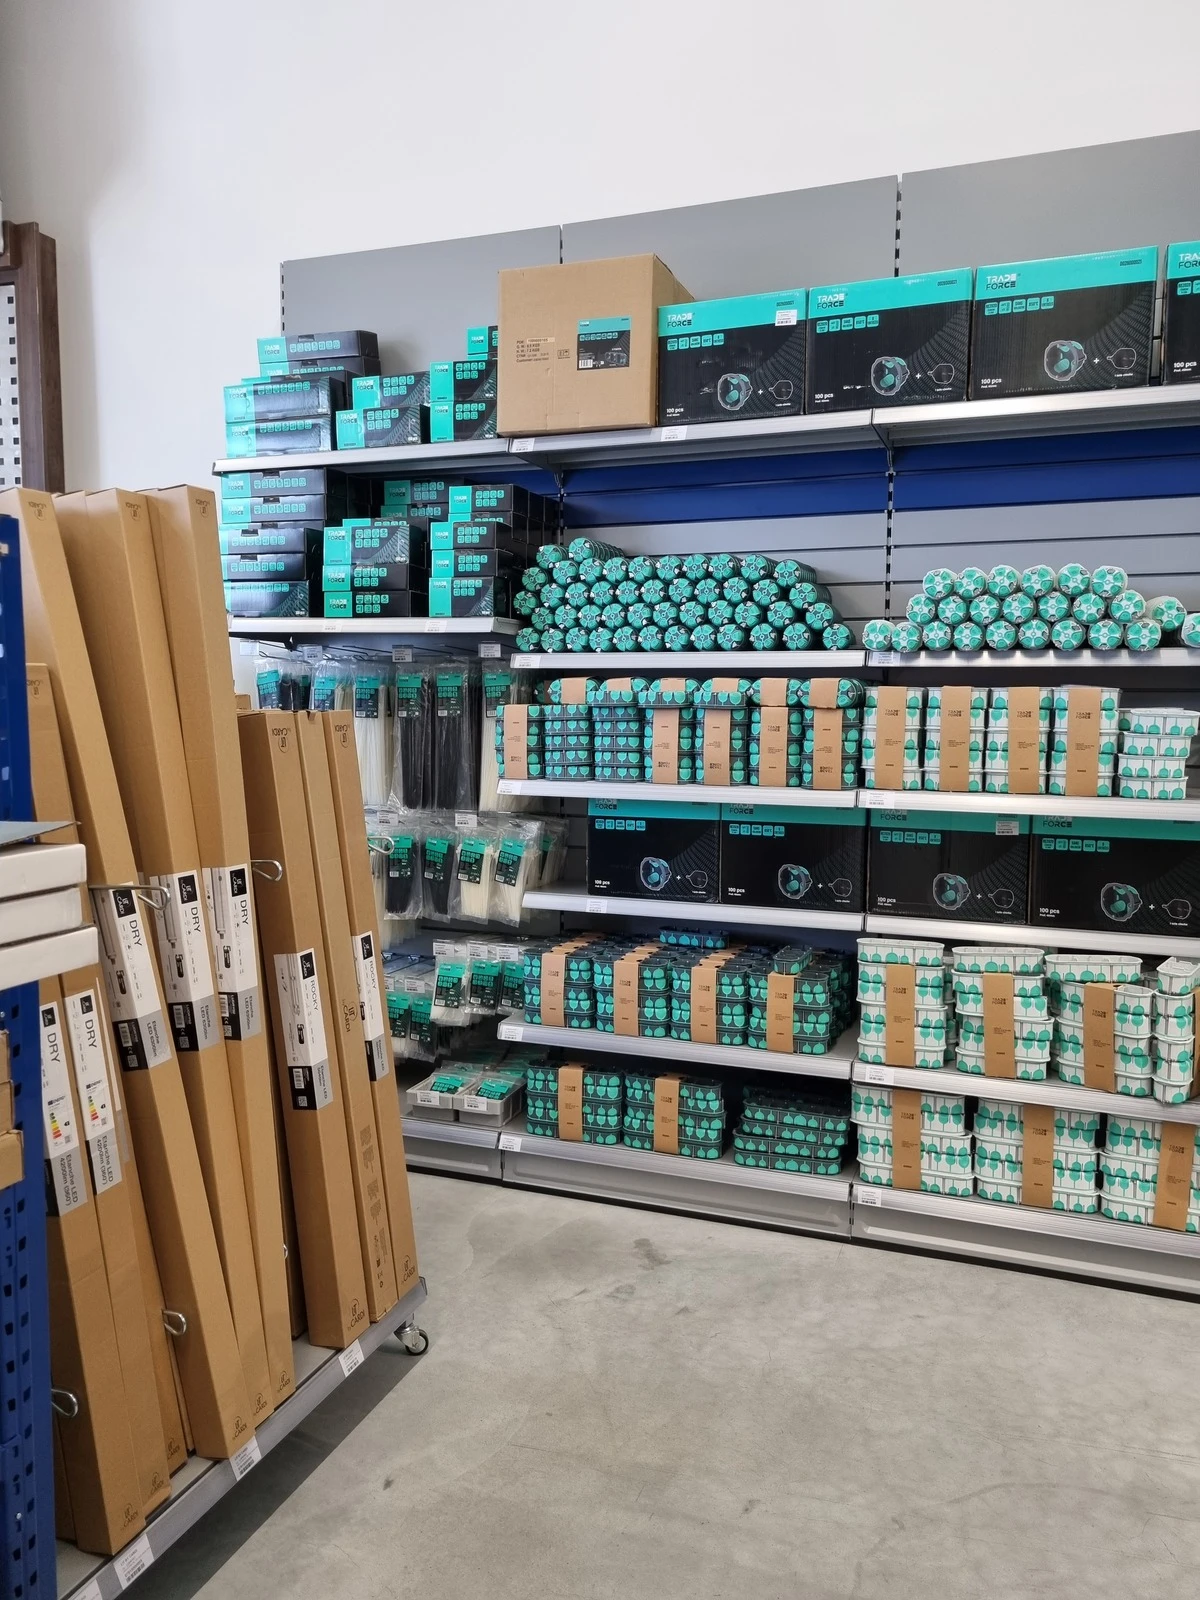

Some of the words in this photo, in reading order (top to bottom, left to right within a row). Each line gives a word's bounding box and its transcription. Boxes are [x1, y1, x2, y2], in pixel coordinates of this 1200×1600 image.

[986, 274, 1016, 283] TRADE
[986, 282, 1016, 290] FORCE
[817, 294, 844, 302] TRADE
[817, 301, 844, 309] FORCE
[668, 312, 692, 321] TRADE
[668, 320, 692, 328] FORCE
[272, 728, 287, 736] CARDI
[191, 907, 200, 933] DRY
[240, 900, 248, 925] DRY
[129, 920, 142, 946] DRY
[310, 980, 319, 1011] ROCKY
[85, 1019, 97, 1049] DRY
[47, 1032, 61, 1064] DRY
[102, 1135, 110, 1164] Etanche
[106, 1165, 114, 1182] LED
[60, 1157, 68, 1186] 4200lm
[66, 1154, 74, 1184] Etanche
[70, 1185, 78, 1203] LED
[404, 1266, 415, 1283] CARDI
[351, 1310, 365, 1328] CARDI
[279, 1378, 290, 1390] CARDI
[256, 1400, 267, 1414] CARDI
[235, 1424, 248, 1438] CARDI
[123, 1510, 139, 1528] CARDI
